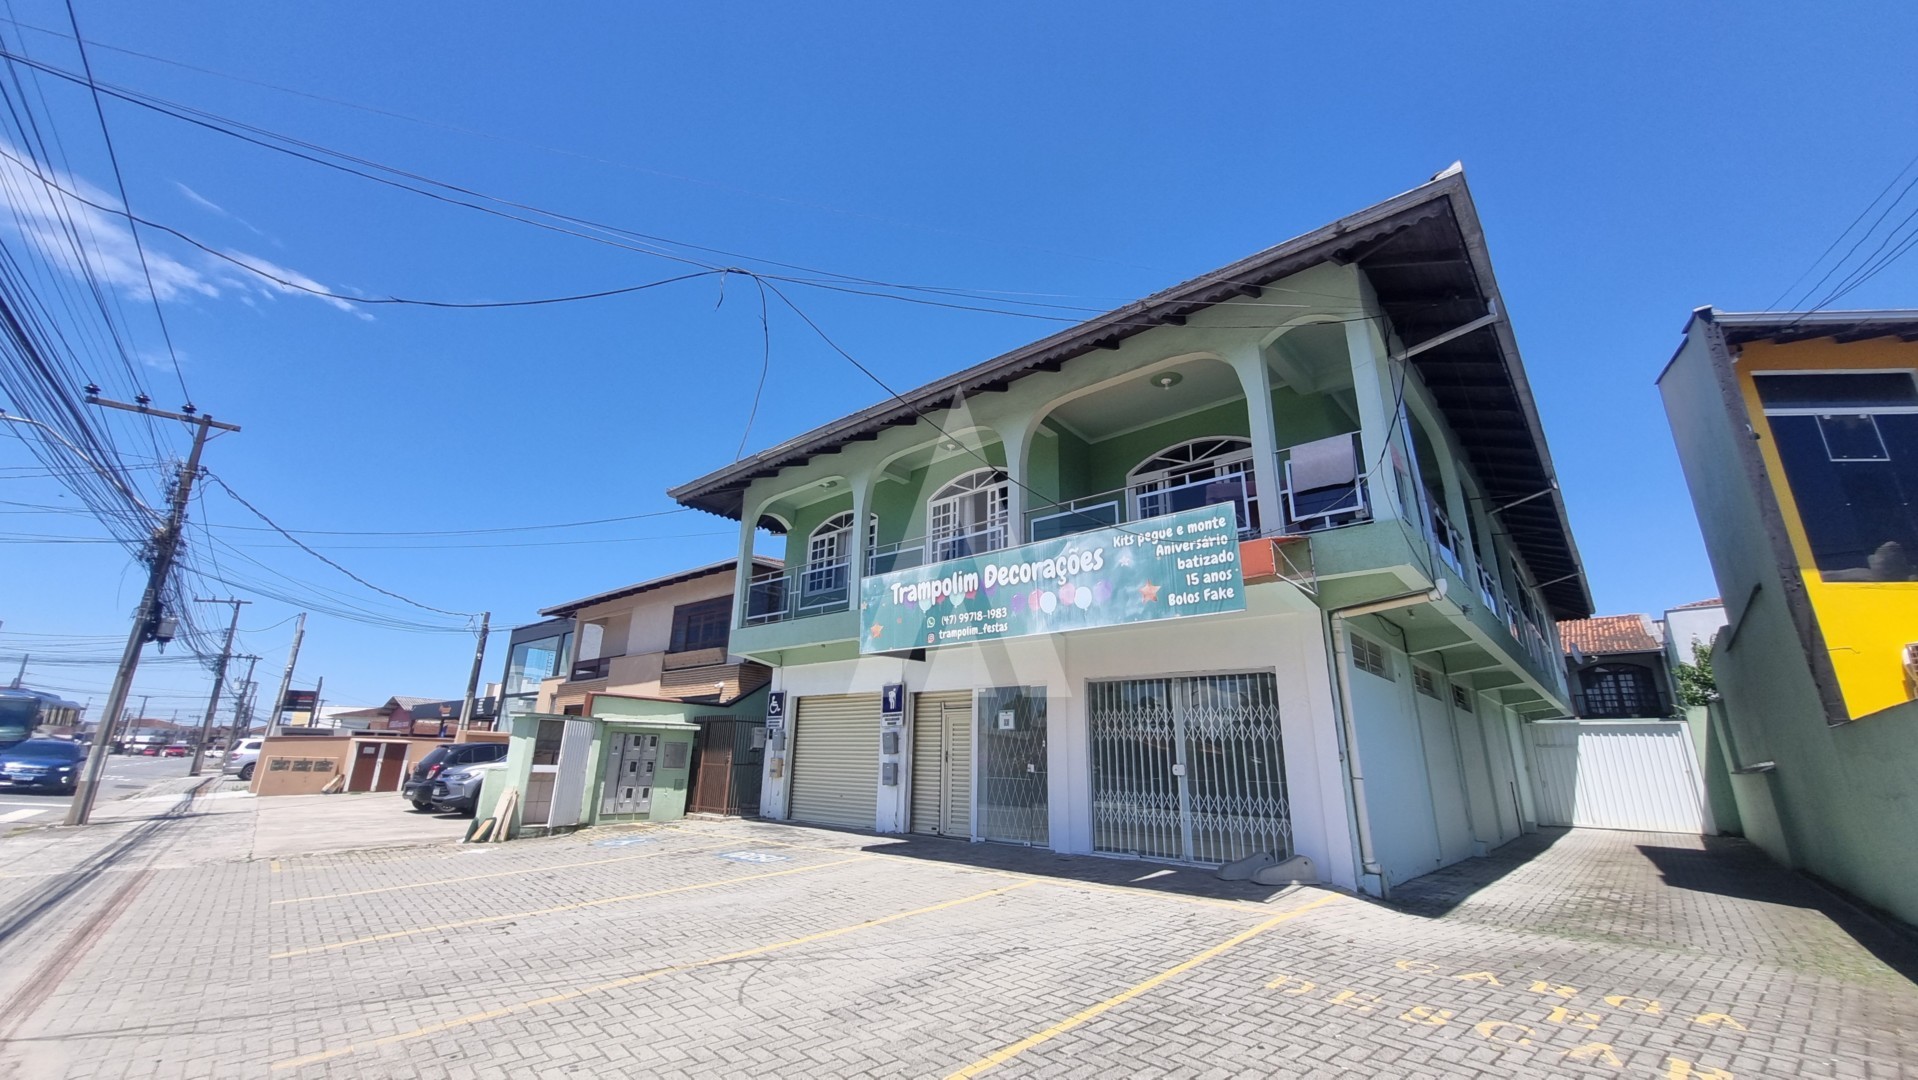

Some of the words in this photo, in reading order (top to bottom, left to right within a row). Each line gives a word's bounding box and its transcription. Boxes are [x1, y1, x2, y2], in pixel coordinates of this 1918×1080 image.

[1113, 535, 1134, 548] Kits
[1137, 527, 1173, 548] pegue
[1176, 525, 1184, 536] e
[1187, 516, 1227, 531] monte
[1155, 533, 1228, 557] Aniversário
[1177, 549, 1235, 570] batizado
[890, 571, 979, 605] Trampolim
[984, 547, 1104, 589] Decorações
[1186, 573, 1199, 586] 15
[1203, 569, 1232, 584] anos
[1168, 592, 1200, 607] Bolos
[1203, 587, 1235, 602] Fake
[941, 613, 957, 626] (47)
[959, 607, 1007, 623] 99718-1983
[938, 621, 1008, 640] trampolim_festas
